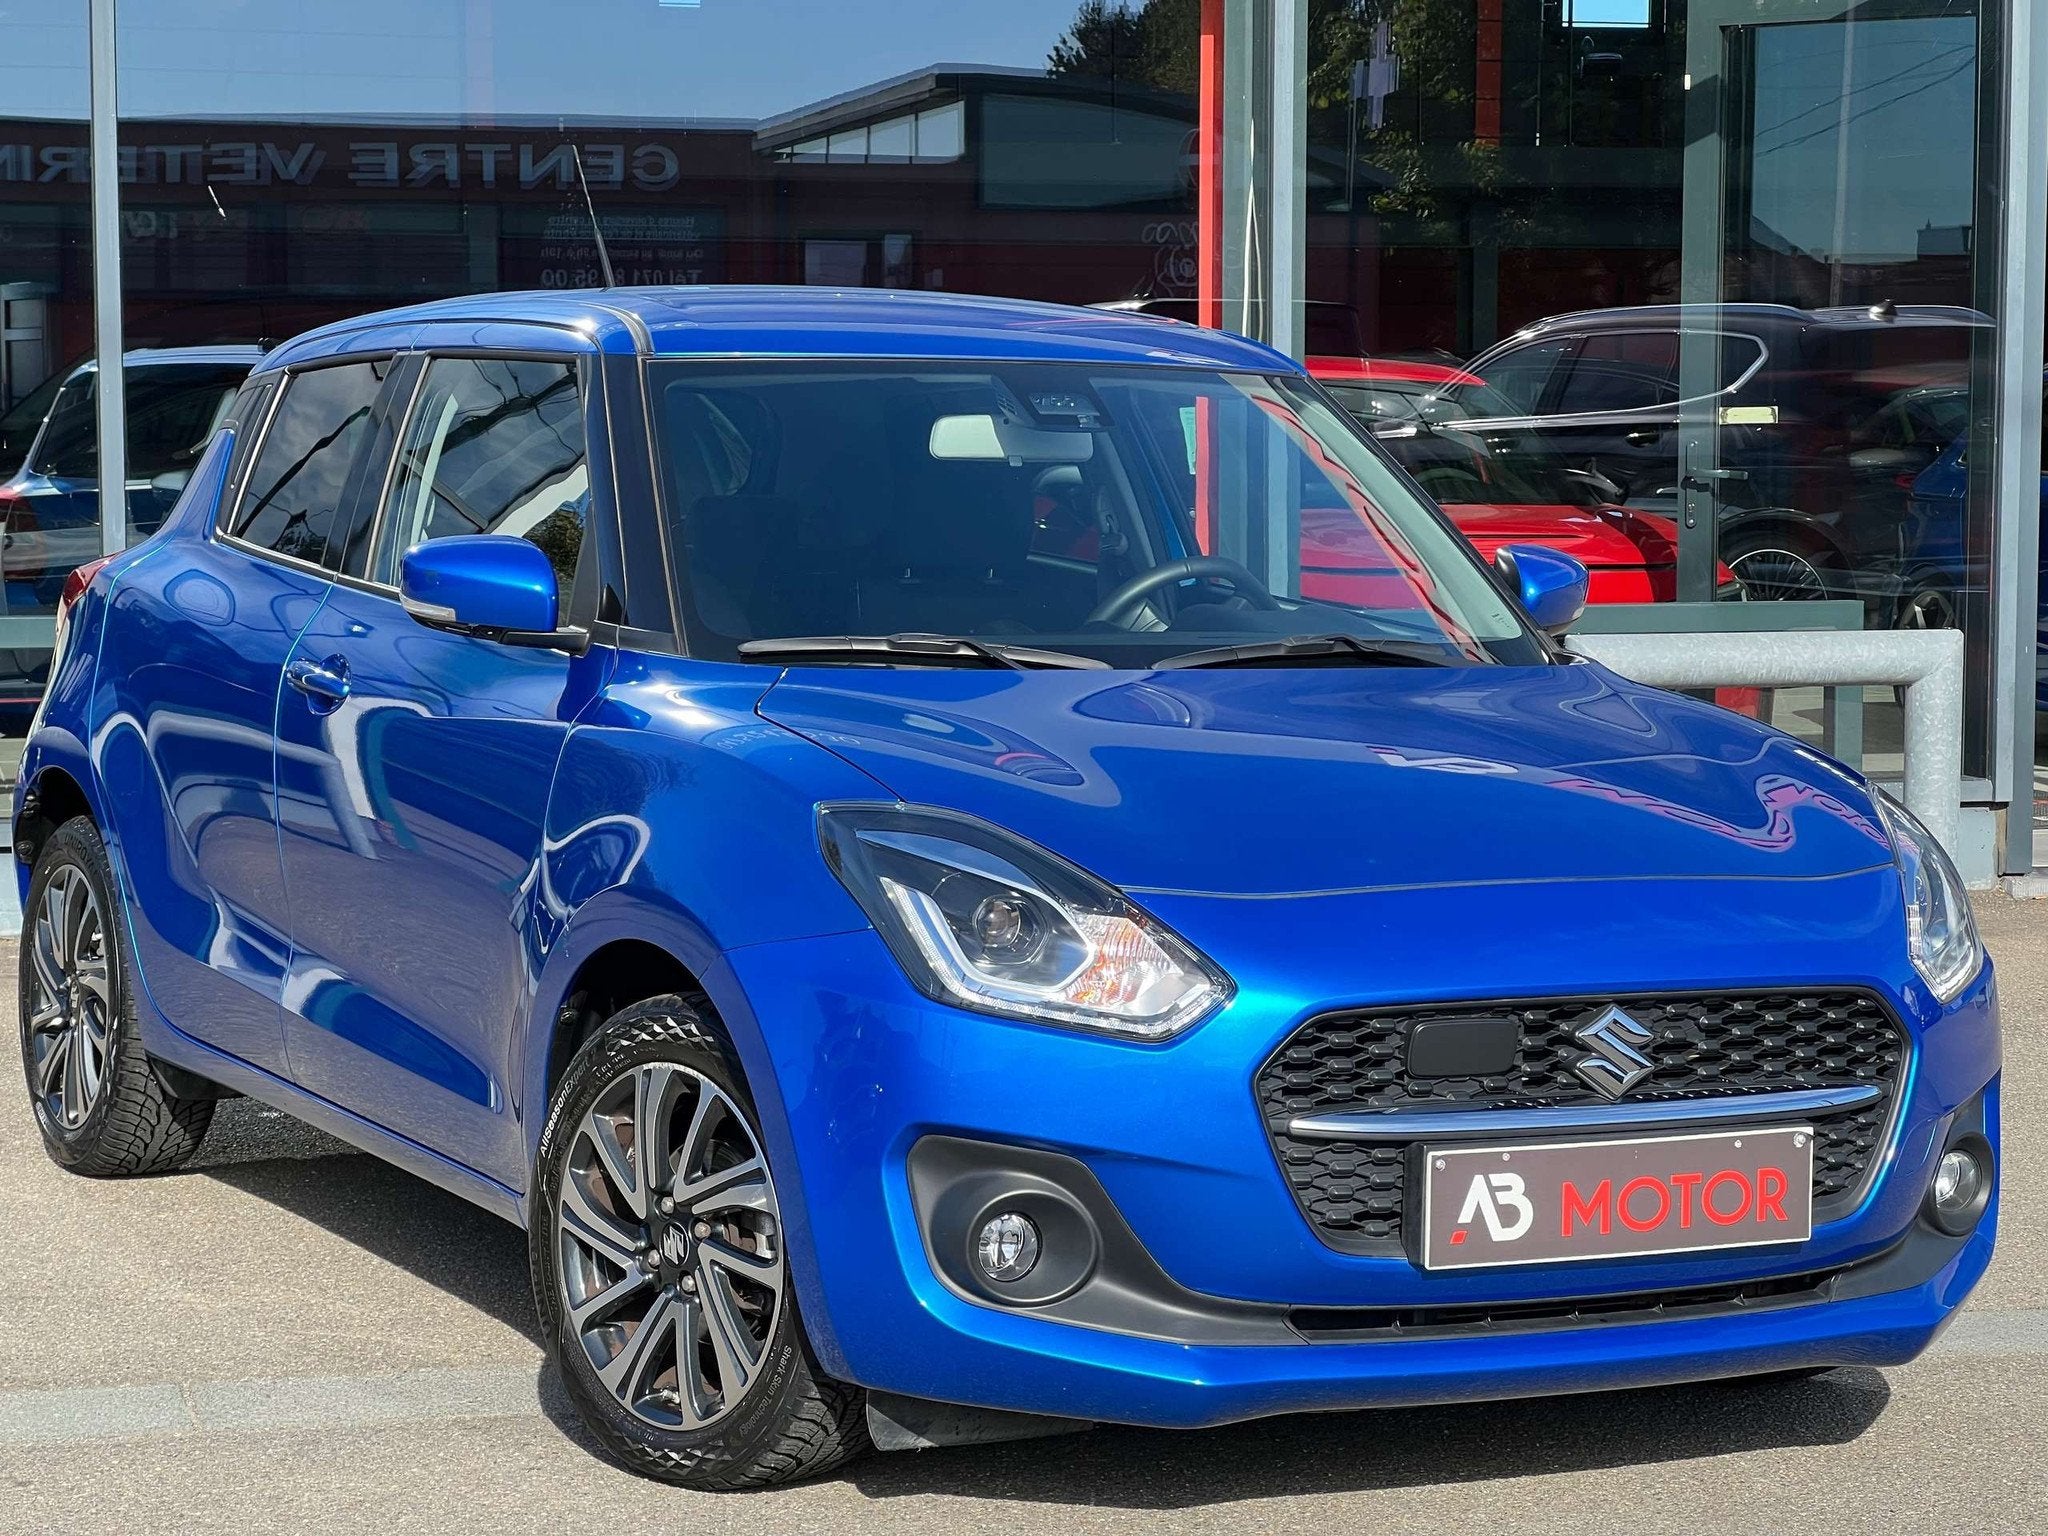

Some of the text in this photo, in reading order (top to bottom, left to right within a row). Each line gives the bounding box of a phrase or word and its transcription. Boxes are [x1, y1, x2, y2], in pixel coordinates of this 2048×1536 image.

[1451, 1166, 1789, 1243] AB MOTOR
[739, 1345, 792, 1437] Shark Skin Technology
